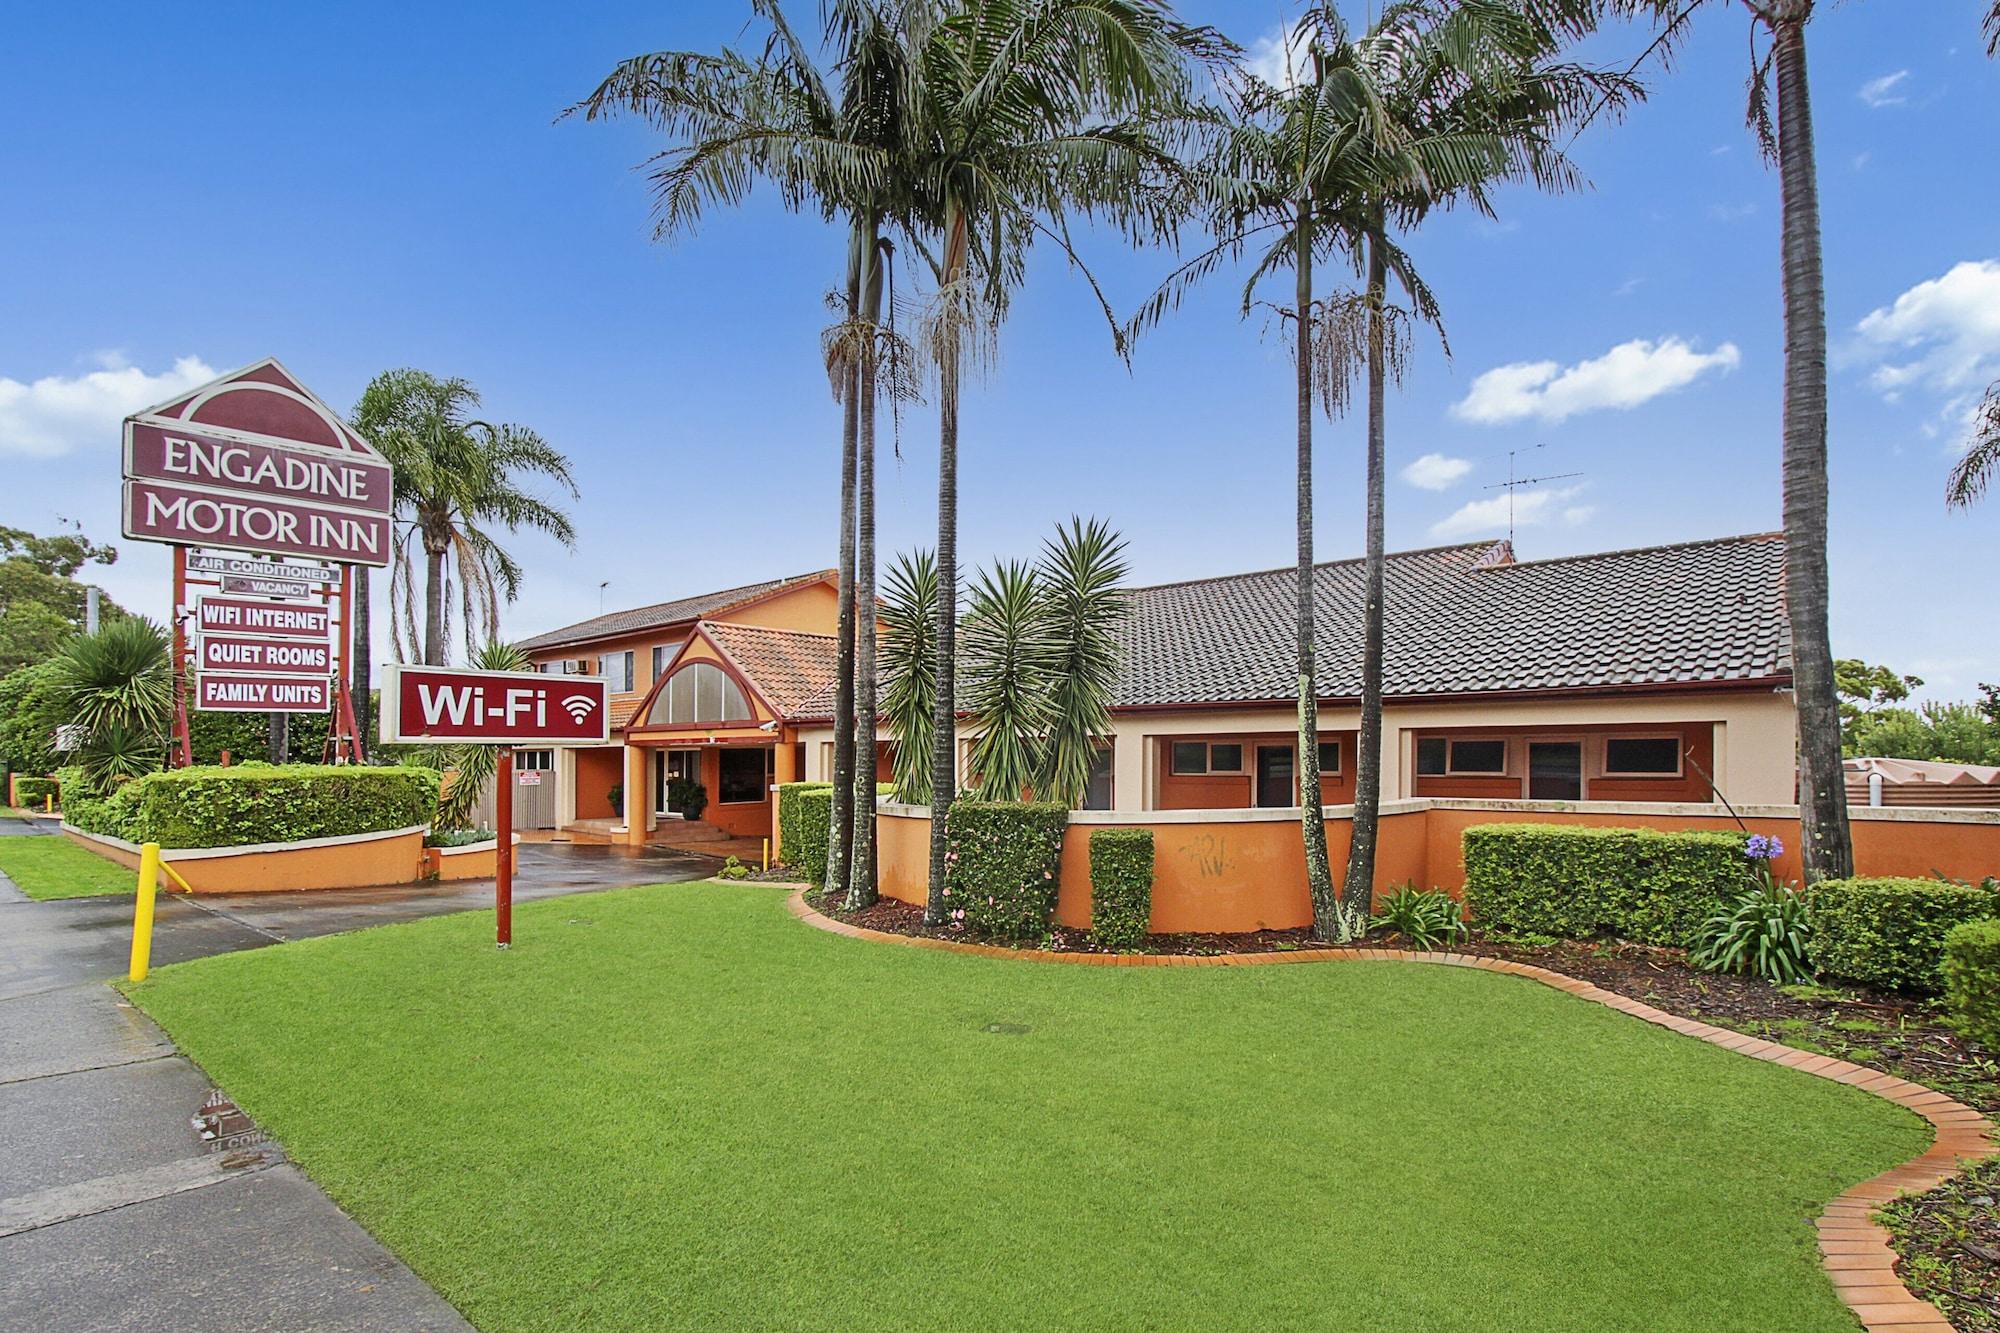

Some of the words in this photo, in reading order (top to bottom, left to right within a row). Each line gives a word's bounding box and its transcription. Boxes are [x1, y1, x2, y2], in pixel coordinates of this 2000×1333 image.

[163, 437, 369, 501] ENGADINE
[144, 492, 302, 545] MOTOR
[309, 515, 378, 554] INN
[199, 558, 225, 570] AIR
[230, 561, 331, 580] CONDITIONED
[251, 581, 306, 595] VACANCY
[203, 605, 241, 625] WIFI
[246, 608, 327, 630] INTERNET
[209, 643, 262, 663] QUIET
[266, 646, 326, 667] ROOMS
[206, 683, 268, 702] FAMILY
[272, 685, 322, 704] UNITS
[418, 684, 546, 727] Wi-Fi
